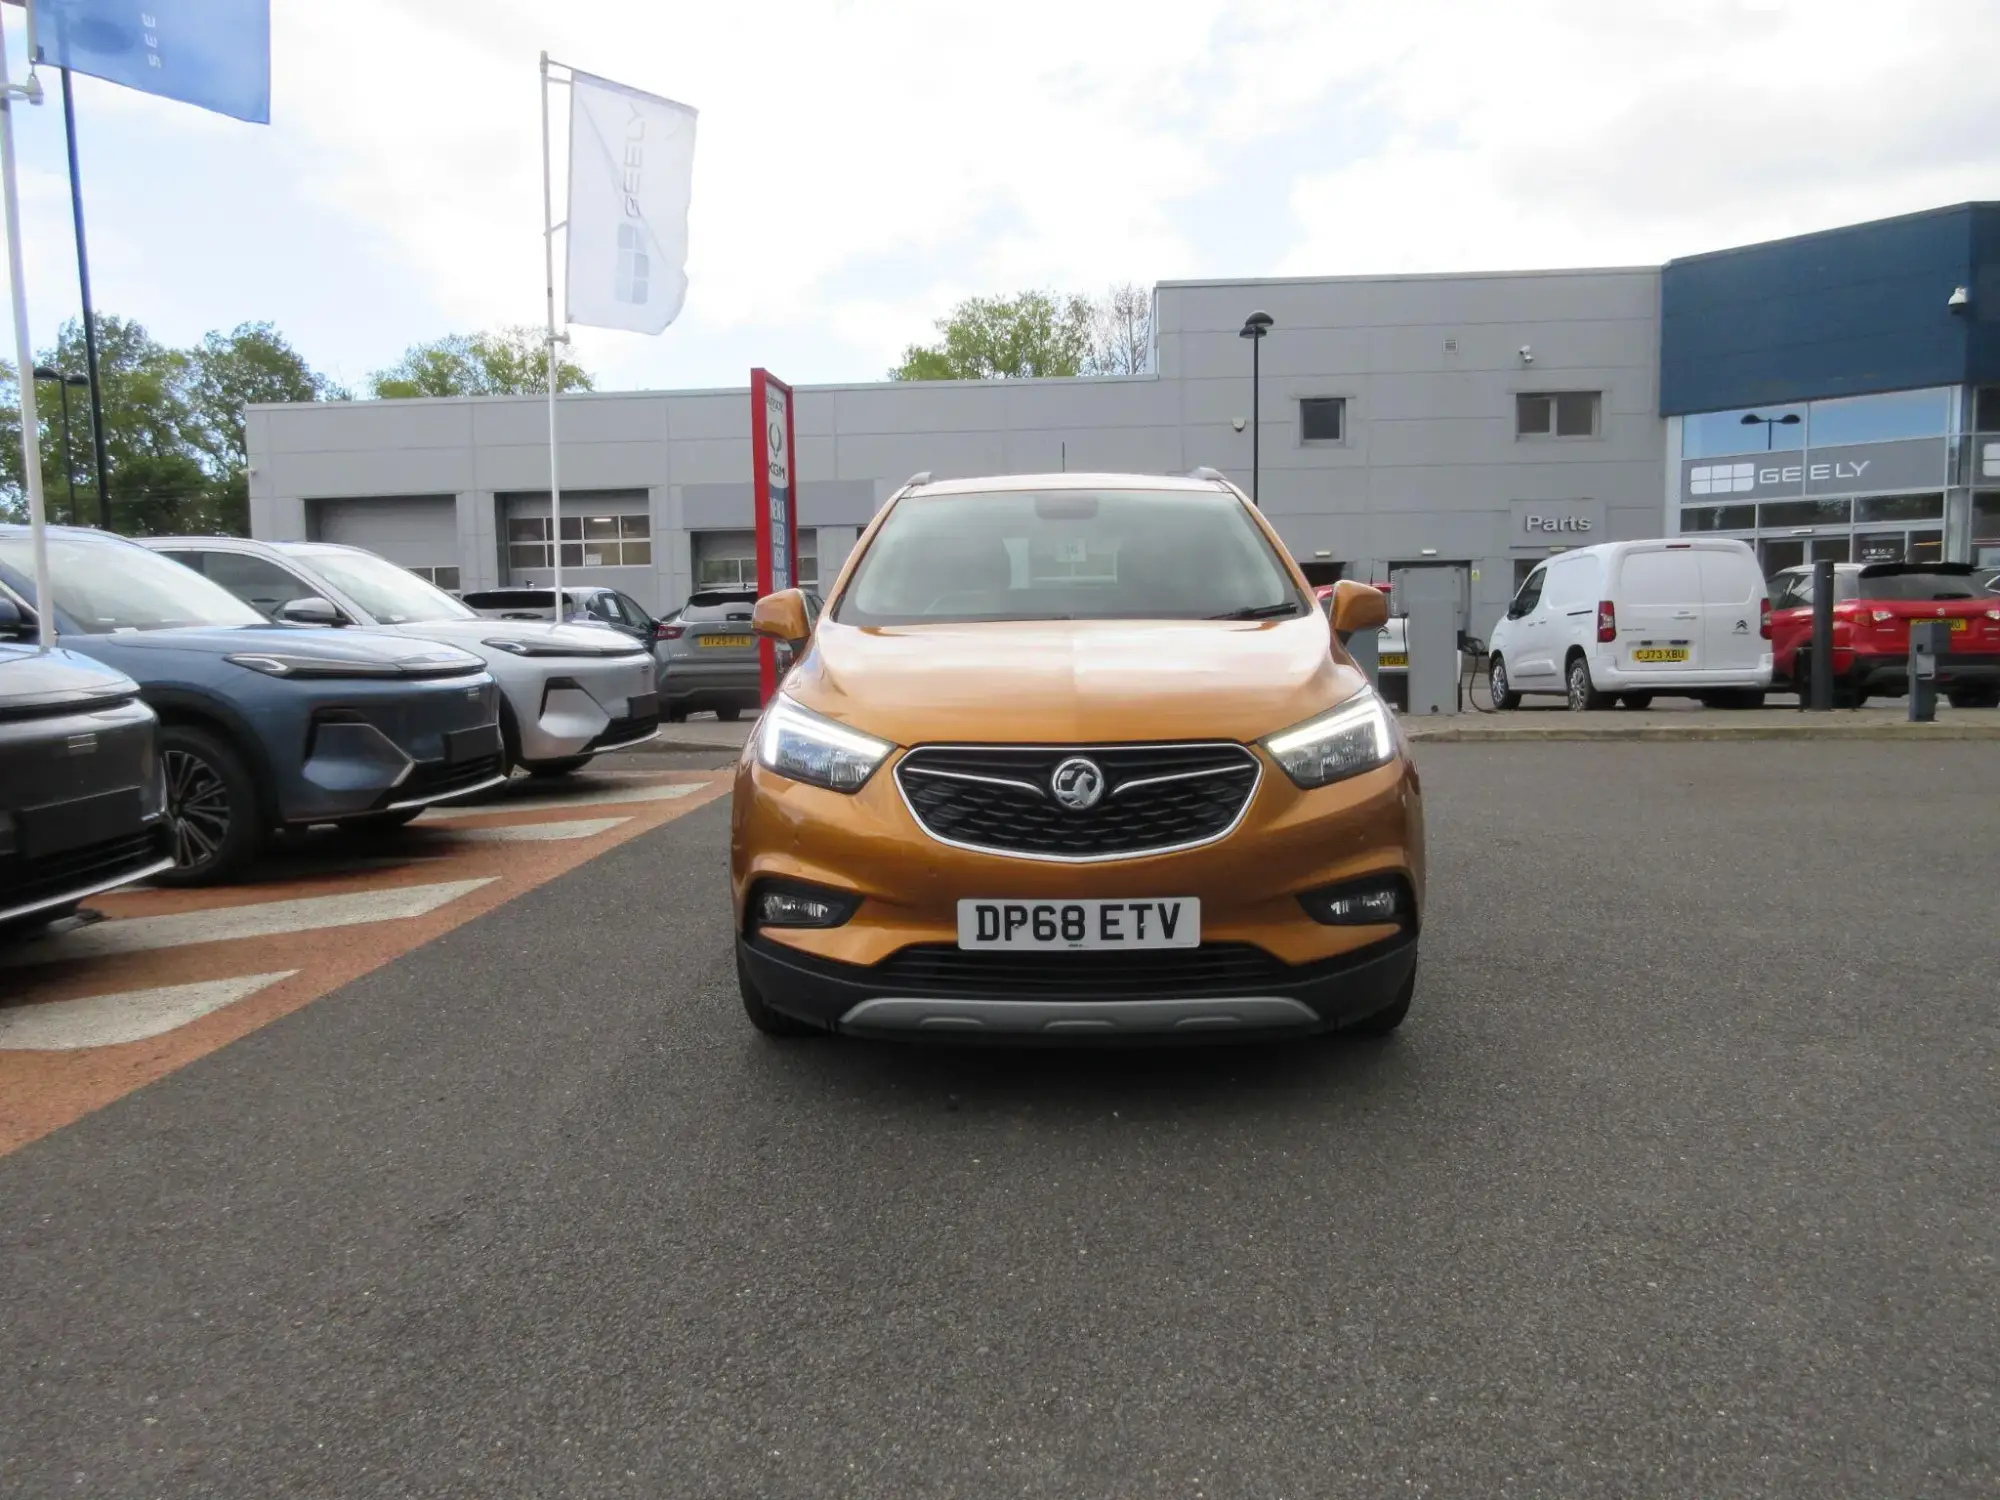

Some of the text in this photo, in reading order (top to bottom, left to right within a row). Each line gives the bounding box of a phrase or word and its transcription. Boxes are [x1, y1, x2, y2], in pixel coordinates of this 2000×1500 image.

[623, 102, 645, 219] GEELY
[1759, 460, 1871, 485] GEELY
[1525, 514, 1593, 533] Parts
[975, 903, 1182, 942] DP68 ETV
